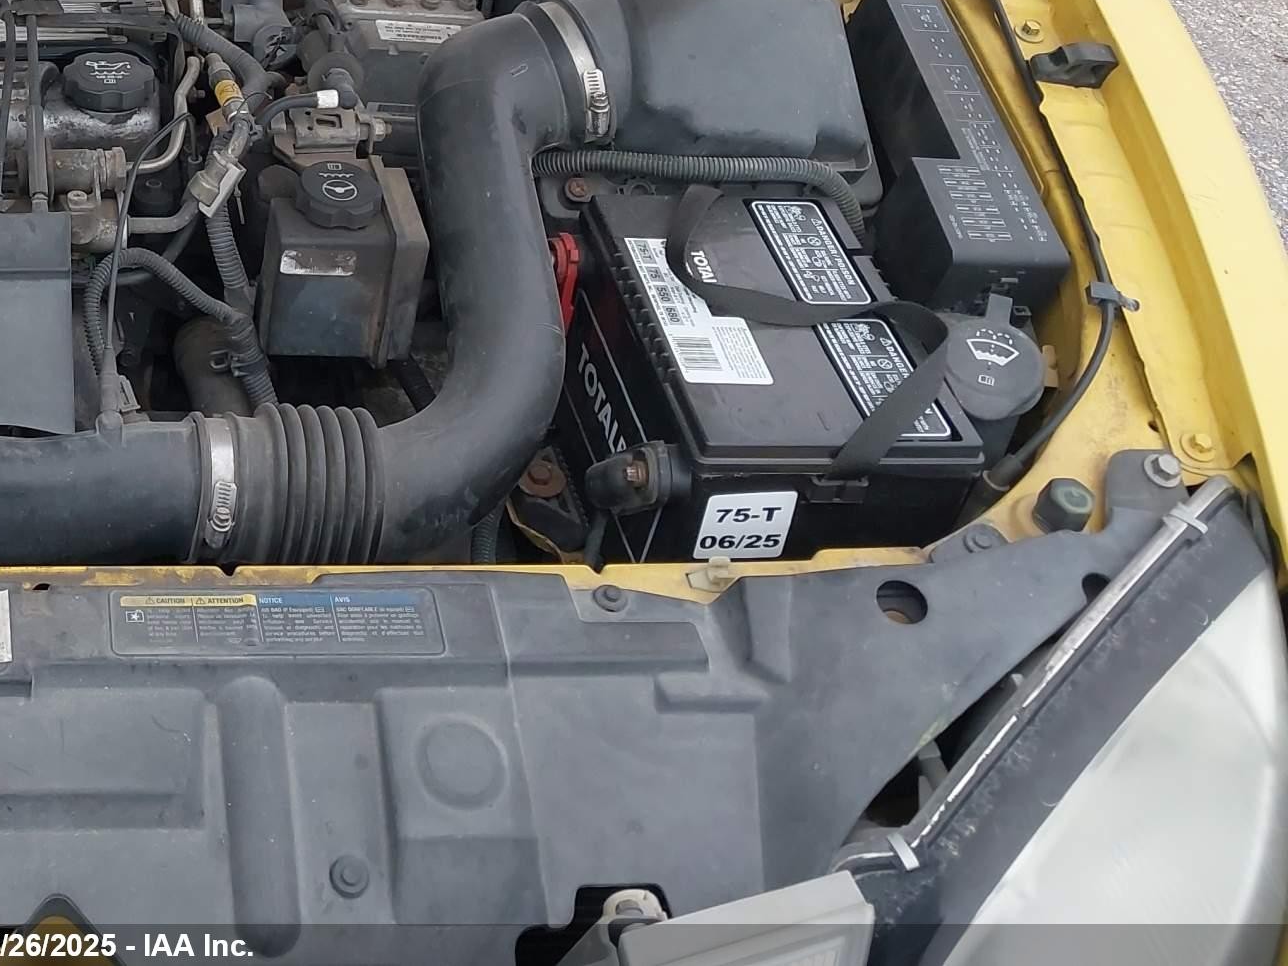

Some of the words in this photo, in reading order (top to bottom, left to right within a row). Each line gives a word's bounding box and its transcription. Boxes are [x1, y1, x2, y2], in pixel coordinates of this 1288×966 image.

[656, 286, 670, 302] 550
[716, 507, 782, 523] 75-T
[700, 534, 781, 549] 06/25
